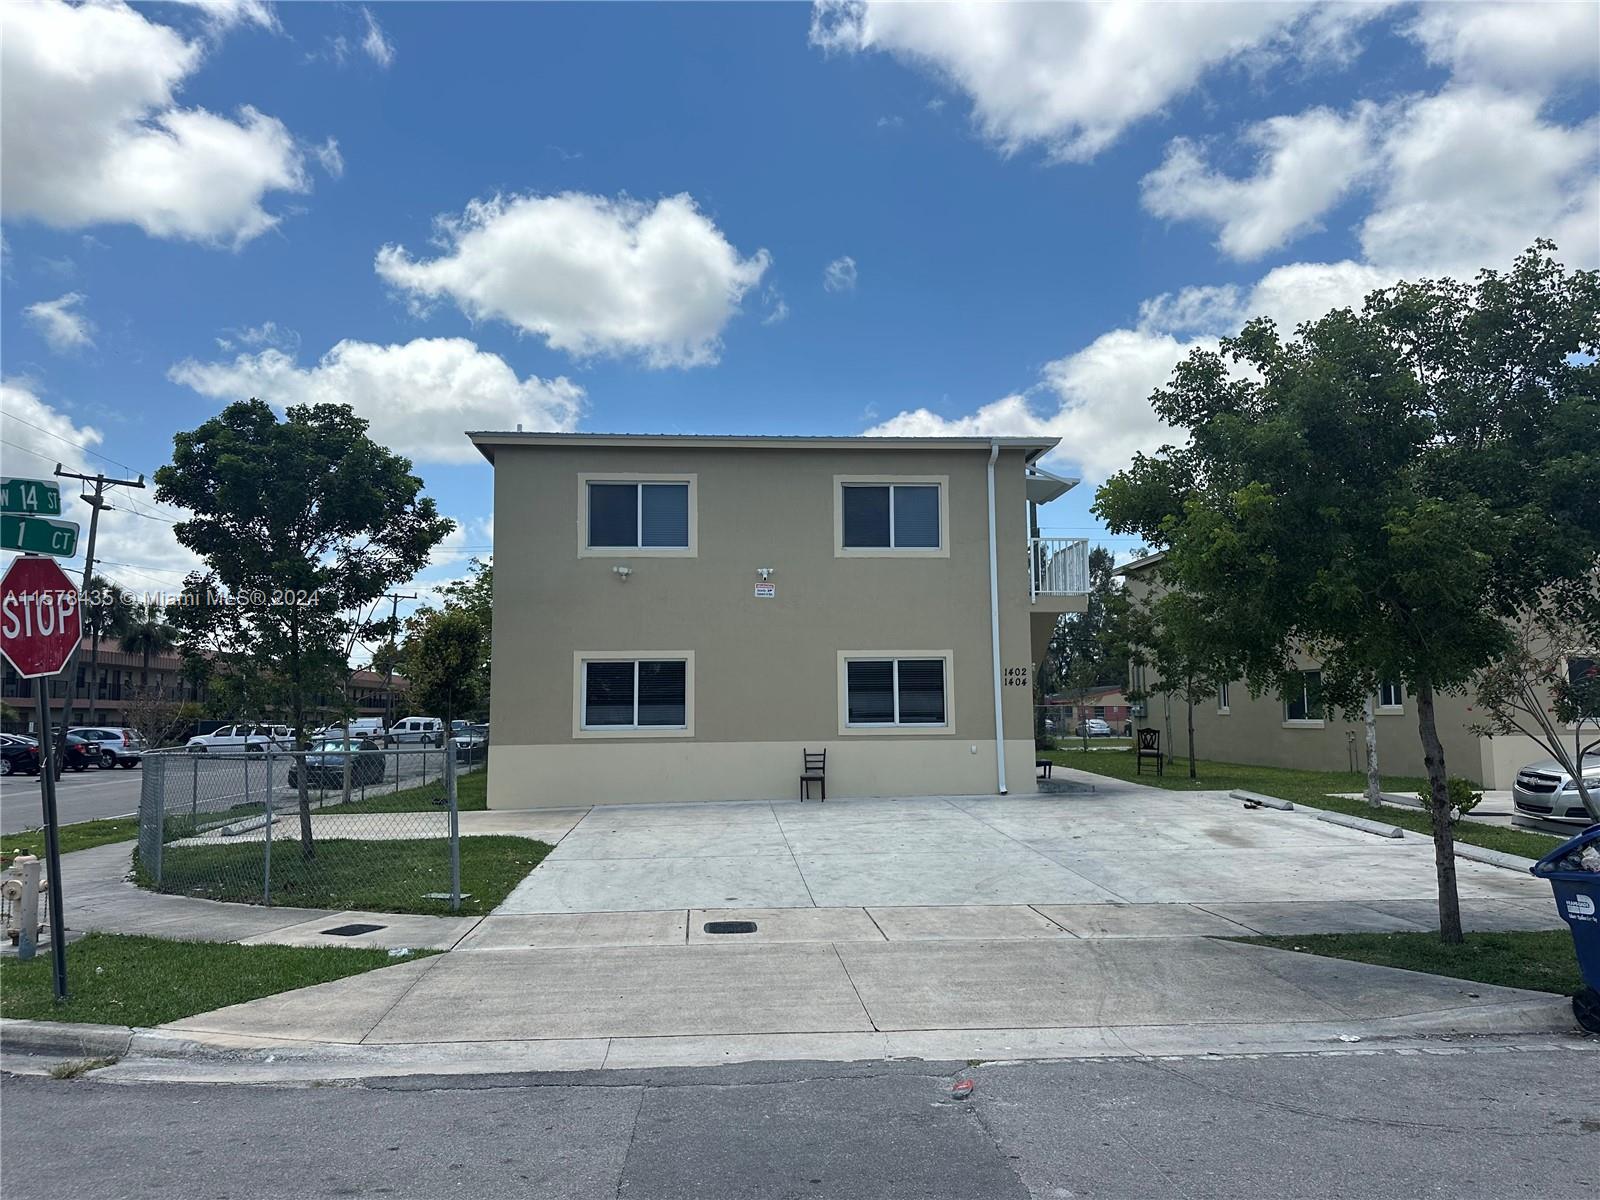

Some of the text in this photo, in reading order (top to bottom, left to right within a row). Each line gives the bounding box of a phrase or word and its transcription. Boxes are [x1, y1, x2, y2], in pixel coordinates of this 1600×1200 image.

[20, 484, 38, 511] 14
[47, 491, 58, 510] ST
[17, 521, 71, 550] 1 CT
[2, 593, 75, 639] STOP
[1004, 668, 1027, 676] 1402
[1004, 678, 1028, 686] 1404
